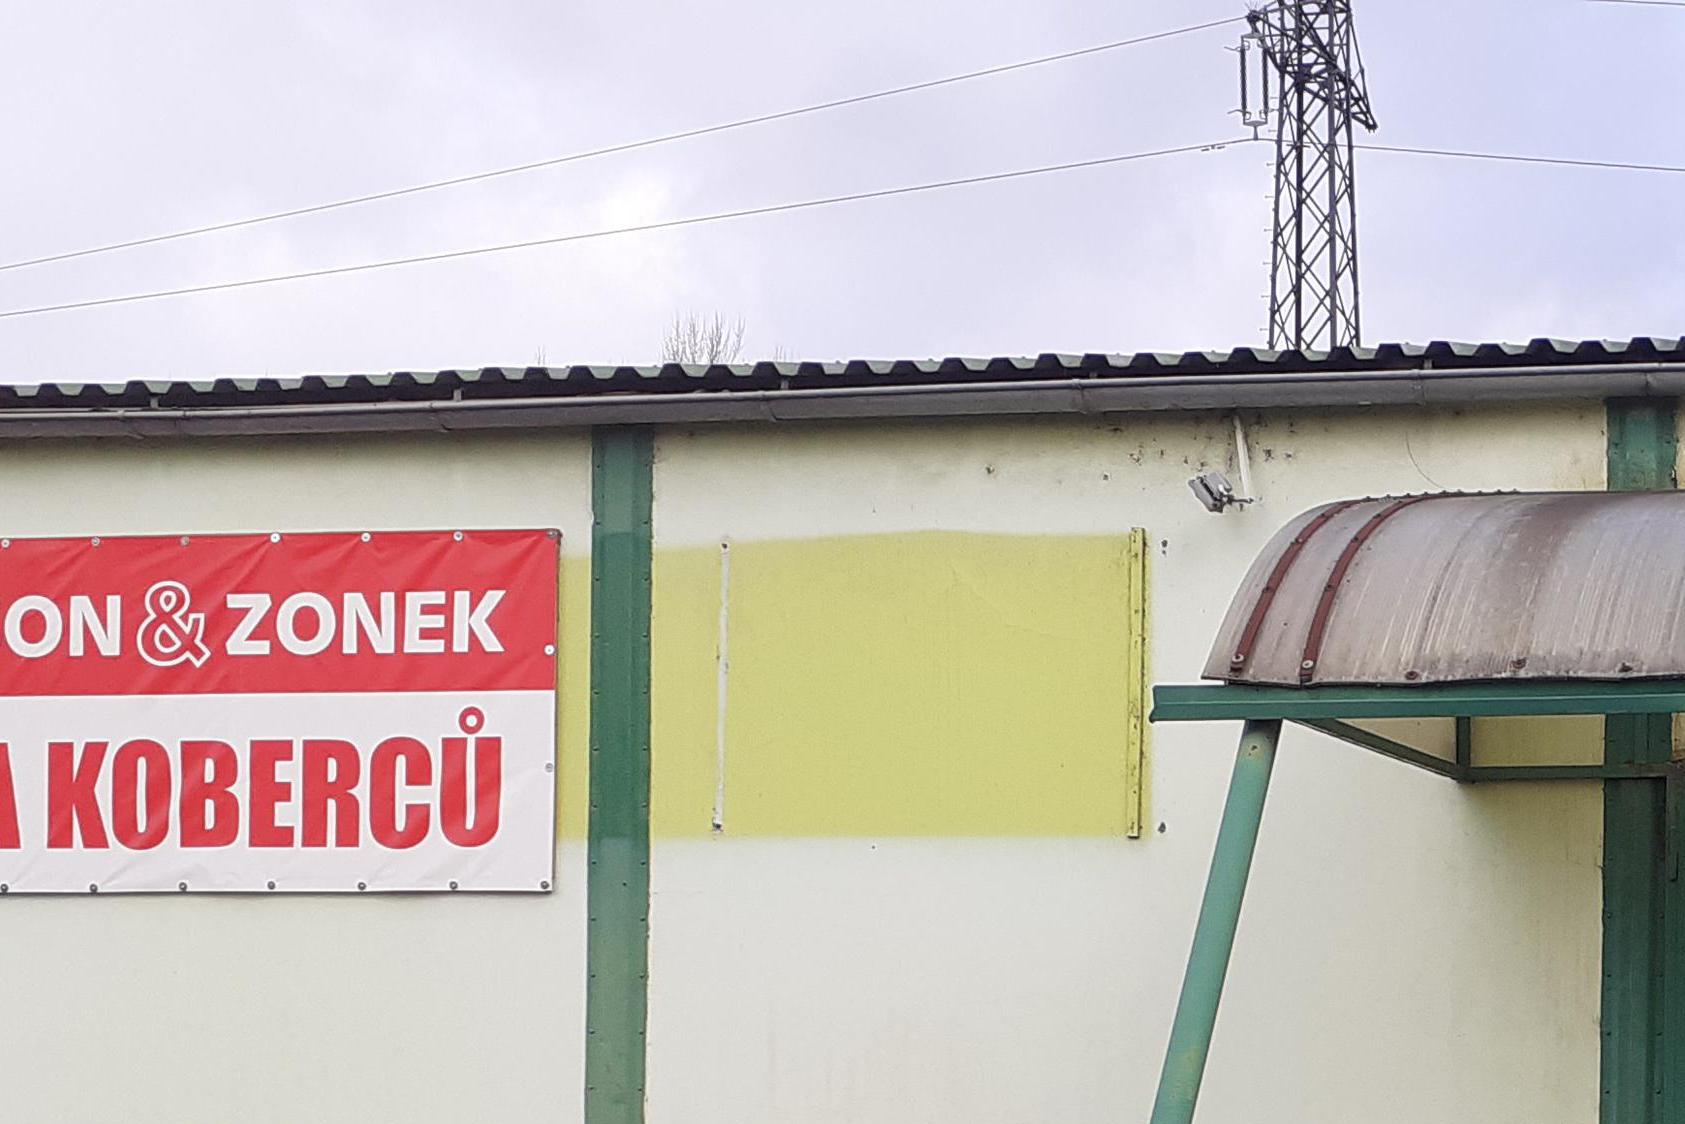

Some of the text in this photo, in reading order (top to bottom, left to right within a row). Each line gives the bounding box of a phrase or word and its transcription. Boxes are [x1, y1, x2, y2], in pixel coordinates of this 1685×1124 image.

[136, 580, 211, 668] &
[225, 589, 507, 656] ZONEK
[46, 705, 503, 851] KOBERCŮ
